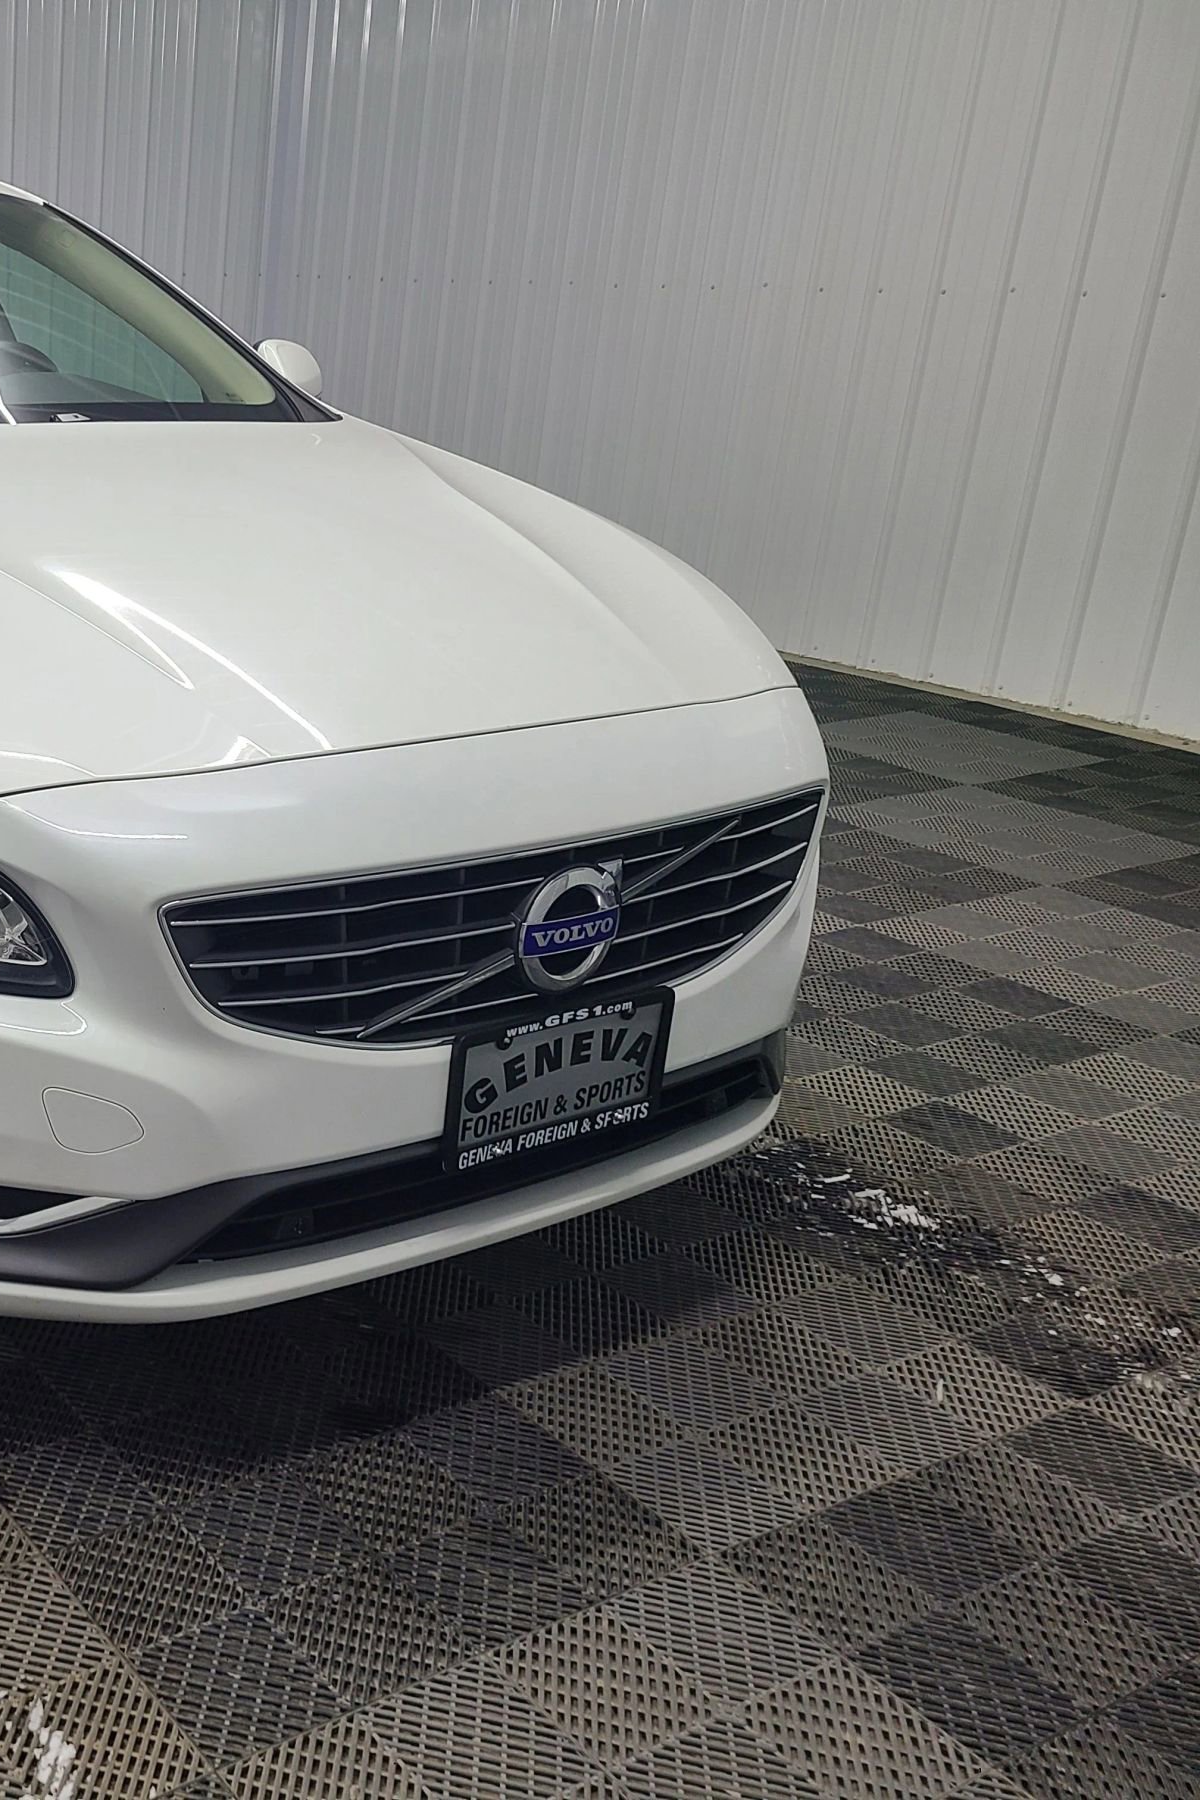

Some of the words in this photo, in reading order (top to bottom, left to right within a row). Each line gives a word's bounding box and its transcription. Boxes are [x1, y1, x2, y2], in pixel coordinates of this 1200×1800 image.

[531, 917, 614, 948] VOLVO
[506, 1000, 633, 1037] www.GFS1.com
[464, 1028, 653, 1114] GENEVA
[460, 1100, 548, 1142] FOREIGN
[553, 1095, 568, 1114] &
[574, 1071, 646, 1109] SPORTS
[458, 1138, 513, 1170] GENEVA
[516, 1122, 578, 1152] FOREIGN
[580, 1117, 591, 1134] &
